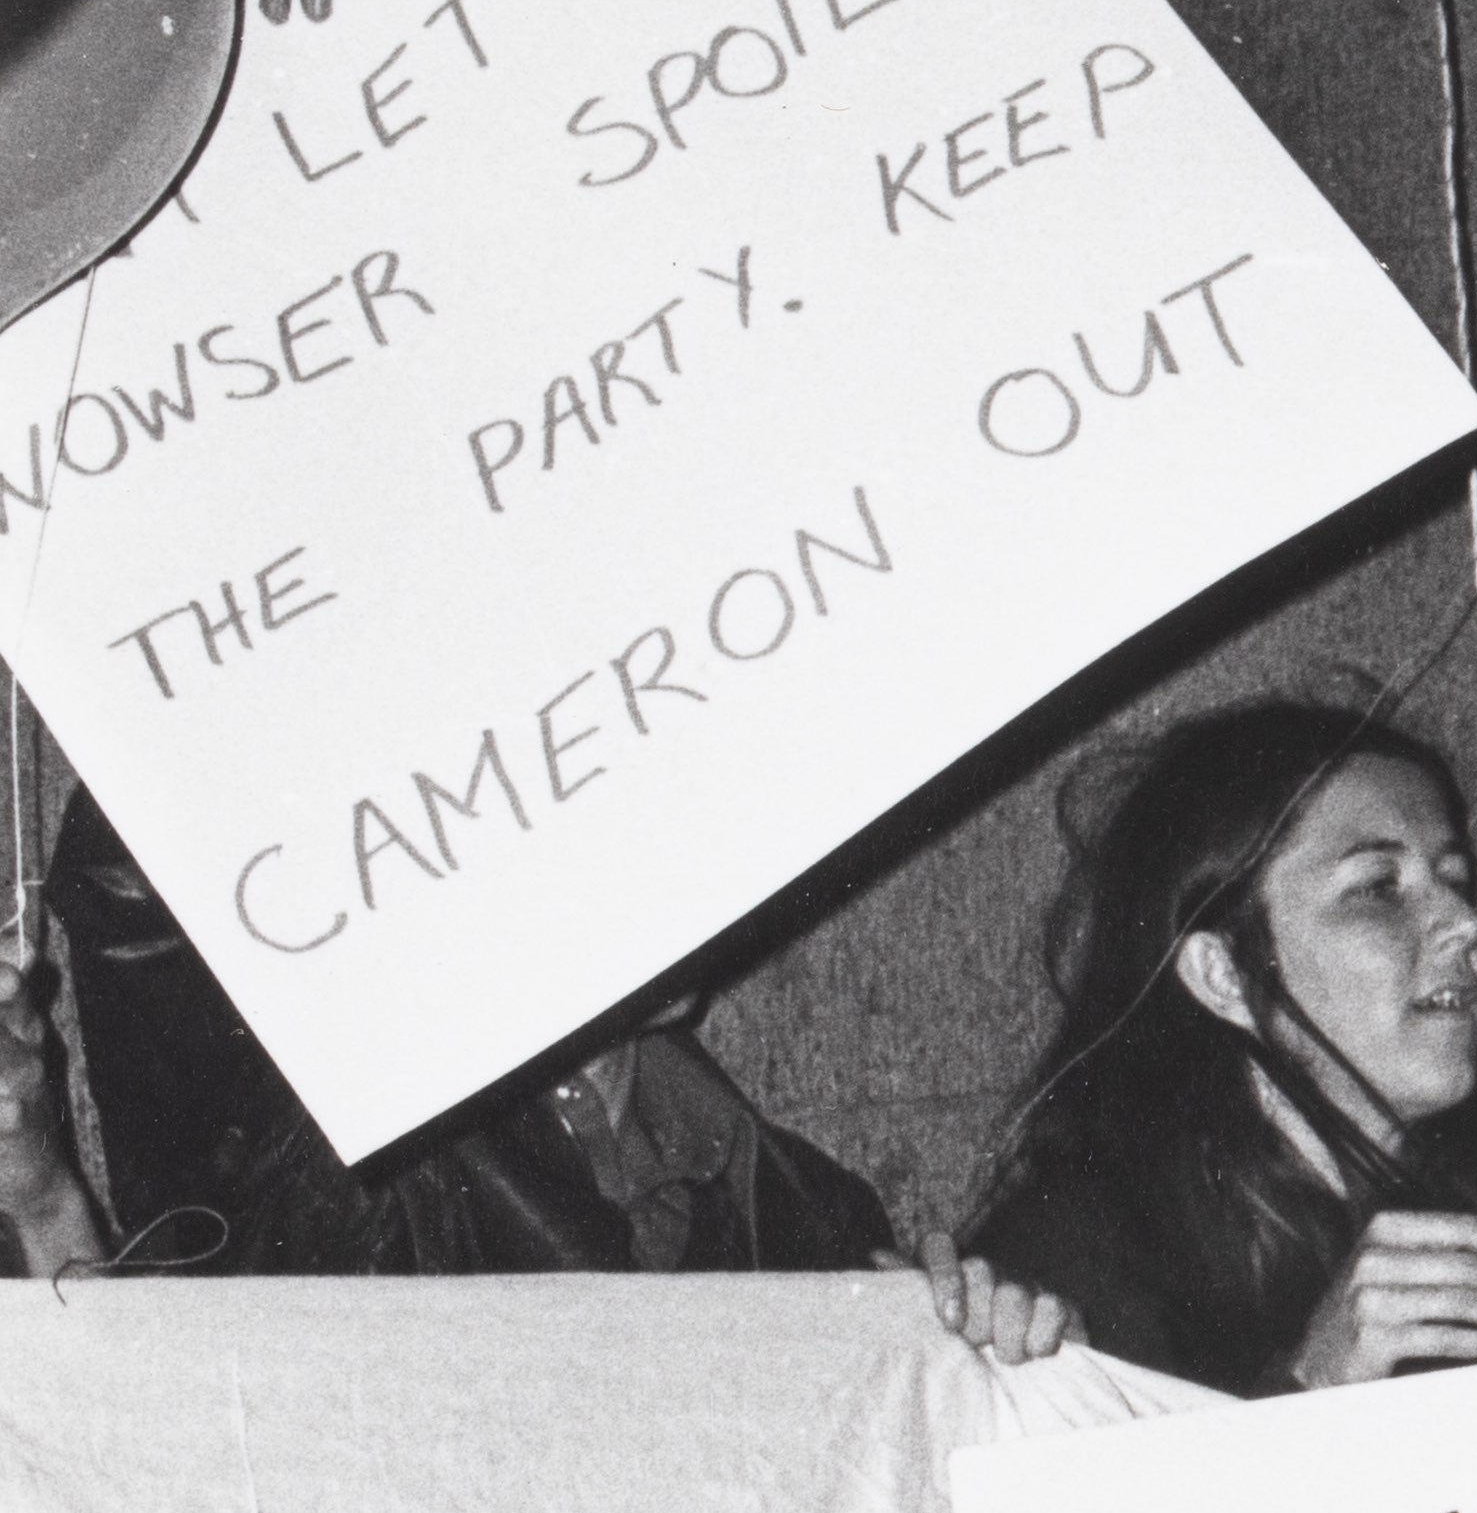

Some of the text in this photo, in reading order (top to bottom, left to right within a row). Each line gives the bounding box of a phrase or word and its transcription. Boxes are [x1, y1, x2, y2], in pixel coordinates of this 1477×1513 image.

[108, 43, 1158, 701] THE PARTY. KEEP
[234, 252, 1257, 957] CAMERON OUT
